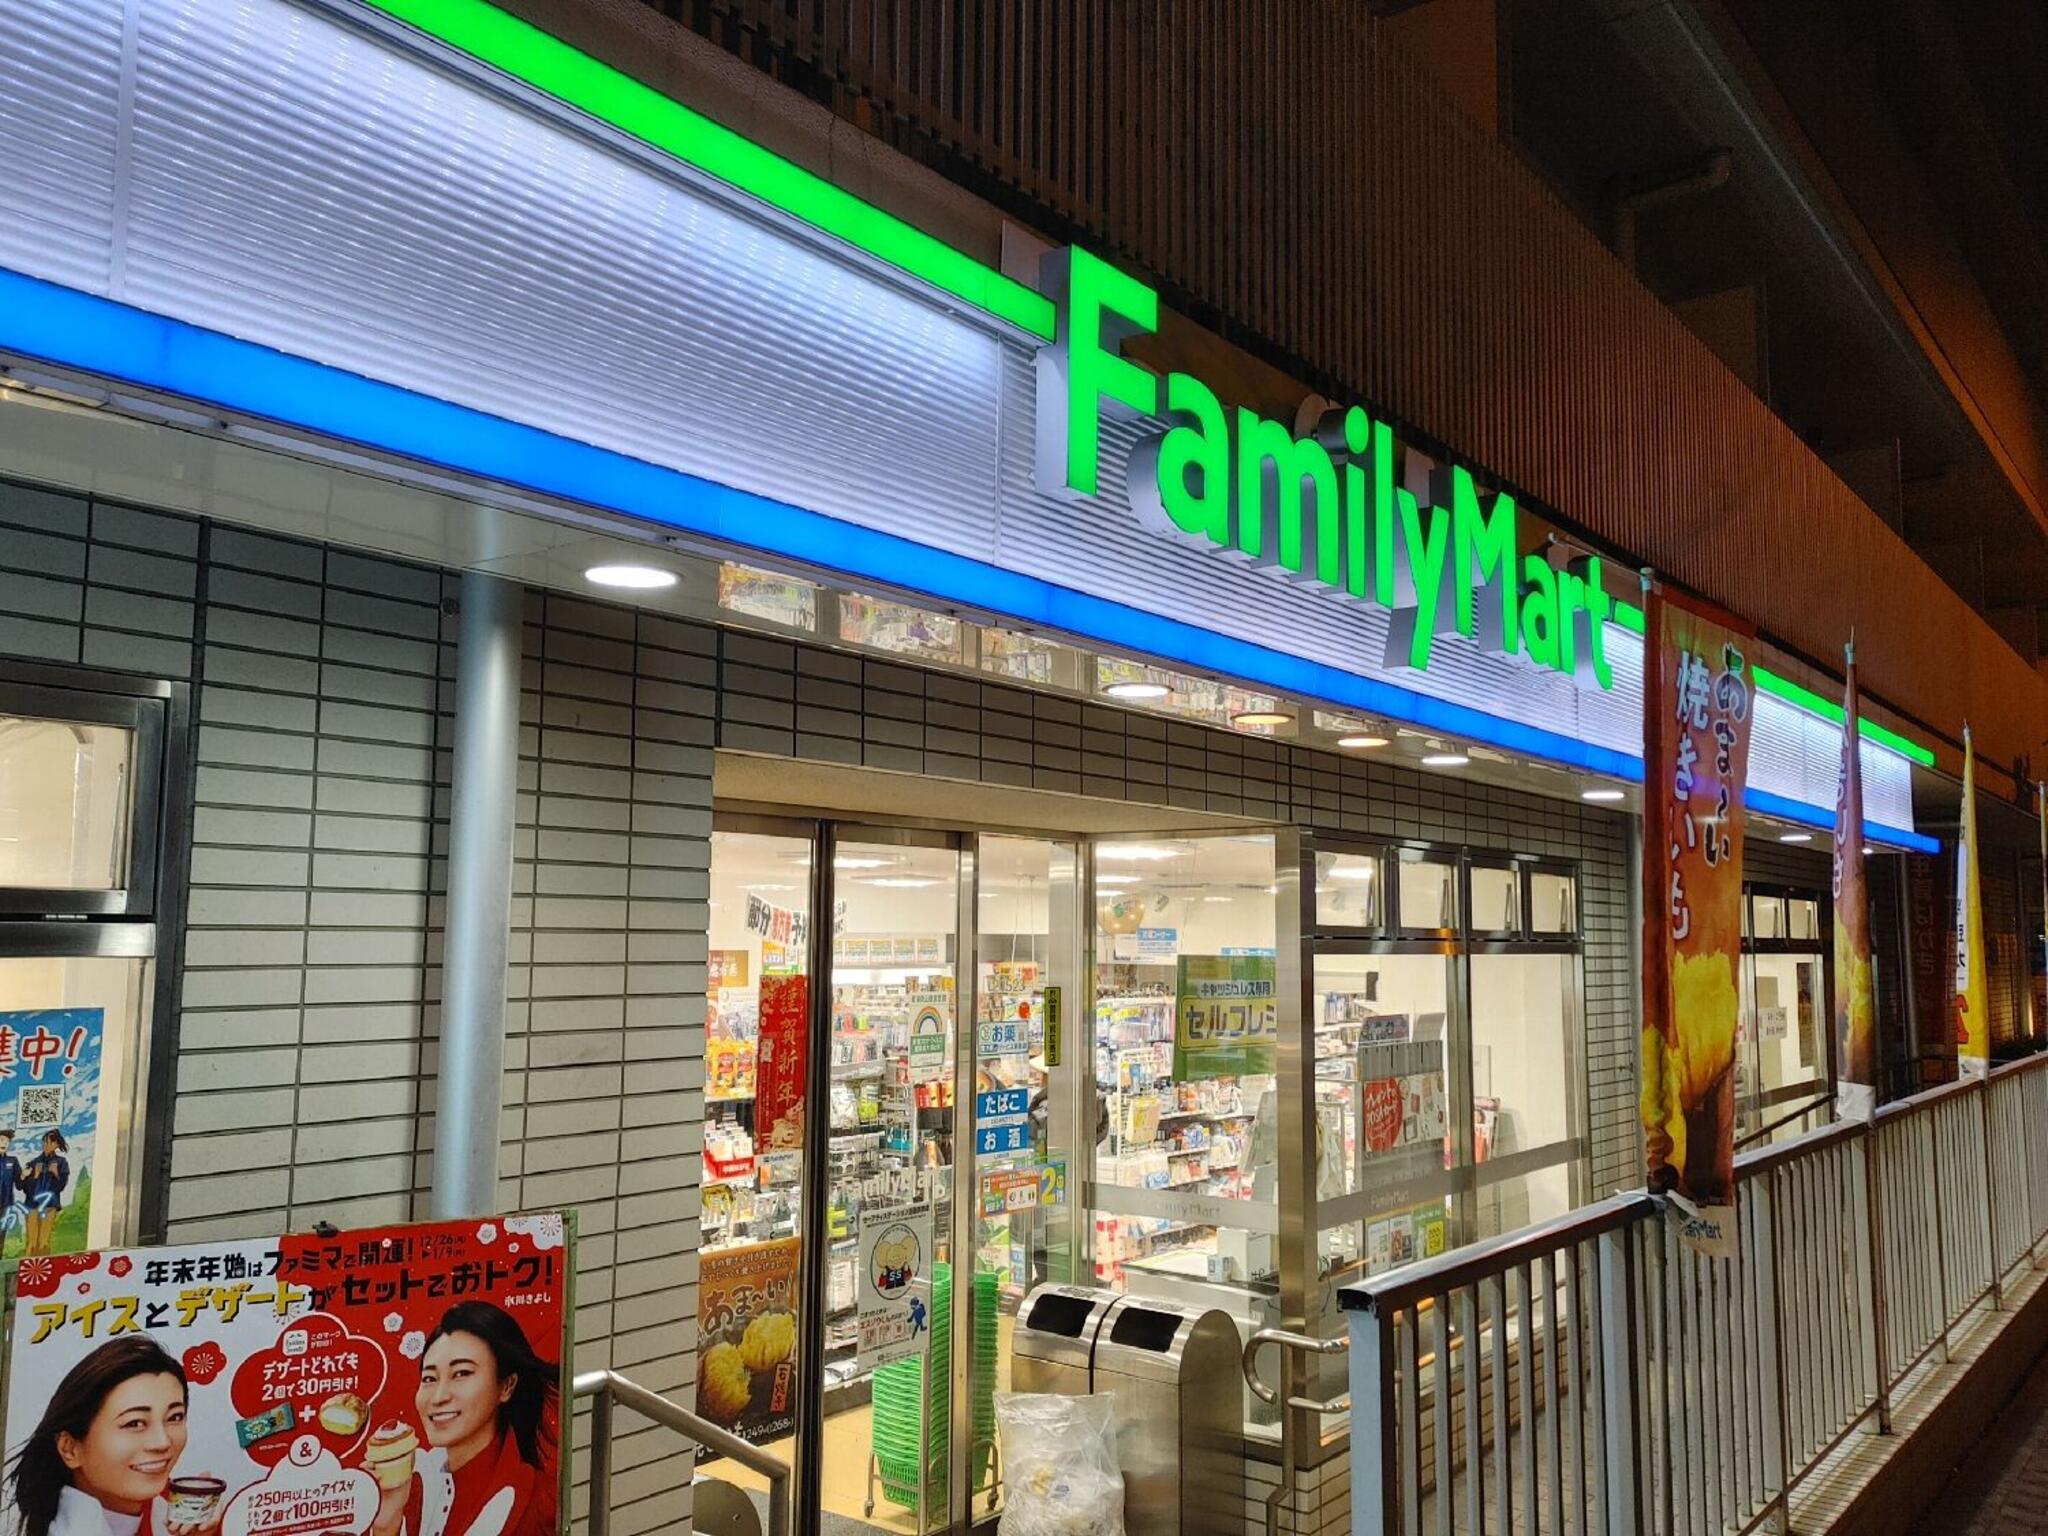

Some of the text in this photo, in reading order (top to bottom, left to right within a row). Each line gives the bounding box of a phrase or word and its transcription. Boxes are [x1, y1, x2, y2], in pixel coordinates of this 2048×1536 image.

[1067, 243, 1613, 690] FamilyMart
[985, 1093, 1020, 1115] たばこ
[984, 1127, 1021, 1151] お酒
[144, 1238, 414, 1287] 年末年始はファミマで開運!
[30, 1255, 553, 1344] アイスとデザートがセットでおトク!
[504, 1291, 551, 1307] 氷川きよし
[262, 1352, 360, 1382] デザートどれでも
[261, 1375, 359, 1402] 2個で30円引き!
[300, 1442, 312, 1457] &
[261, 1497, 355, 1526] 2個で100円引き!
